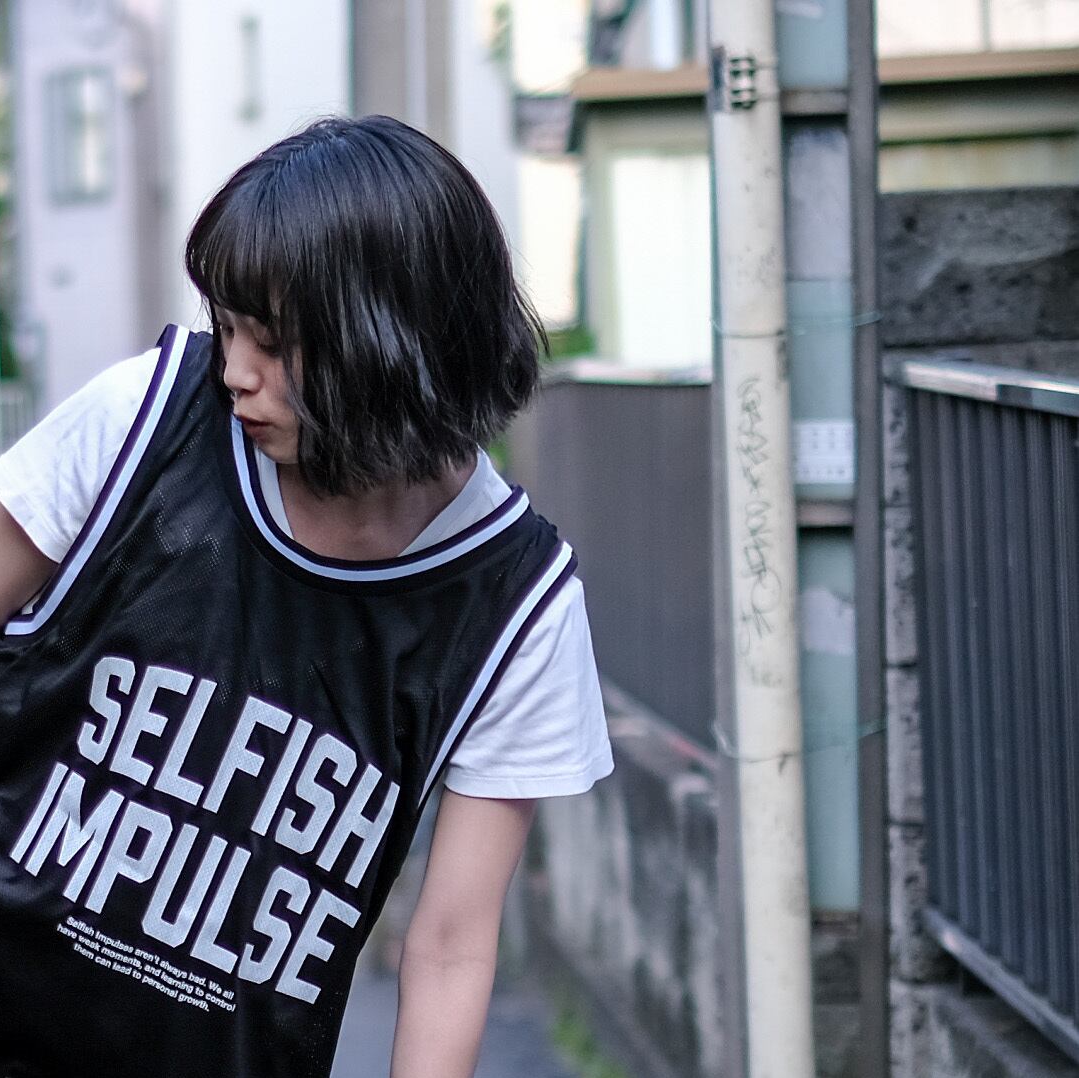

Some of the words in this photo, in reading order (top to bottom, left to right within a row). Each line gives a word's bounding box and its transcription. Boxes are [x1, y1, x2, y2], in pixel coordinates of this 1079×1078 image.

[76, 656, 401, 889] SELFISH
[9, 761, 362, 1004] IMPULSE
[57, 923, 77, 939] have
[78, 934, 101, 952] weak
[100, 946, 143, 970] moments,
[143, 964, 162, 977] and
[160, 971, 194, 994] learning
[194, 986, 205, 997] to
[204, 993, 237, 1012] control
[66, 916, 95, 936] Selfish
[134, 948, 160, 965] aren't
[160, 960, 188, 979] always
[188, 972, 207, 987] bad.
[208, 980, 223, 994] We
[222, 990, 235, 1000] all
[73, 942, 95, 960] them
[94, 956, 112, 968] can
[111, 962, 132, 975] lead
[132, 969, 142, 979] to
[141, 975, 179, 998] personal
[177, 992, 210, 1012] growth.
